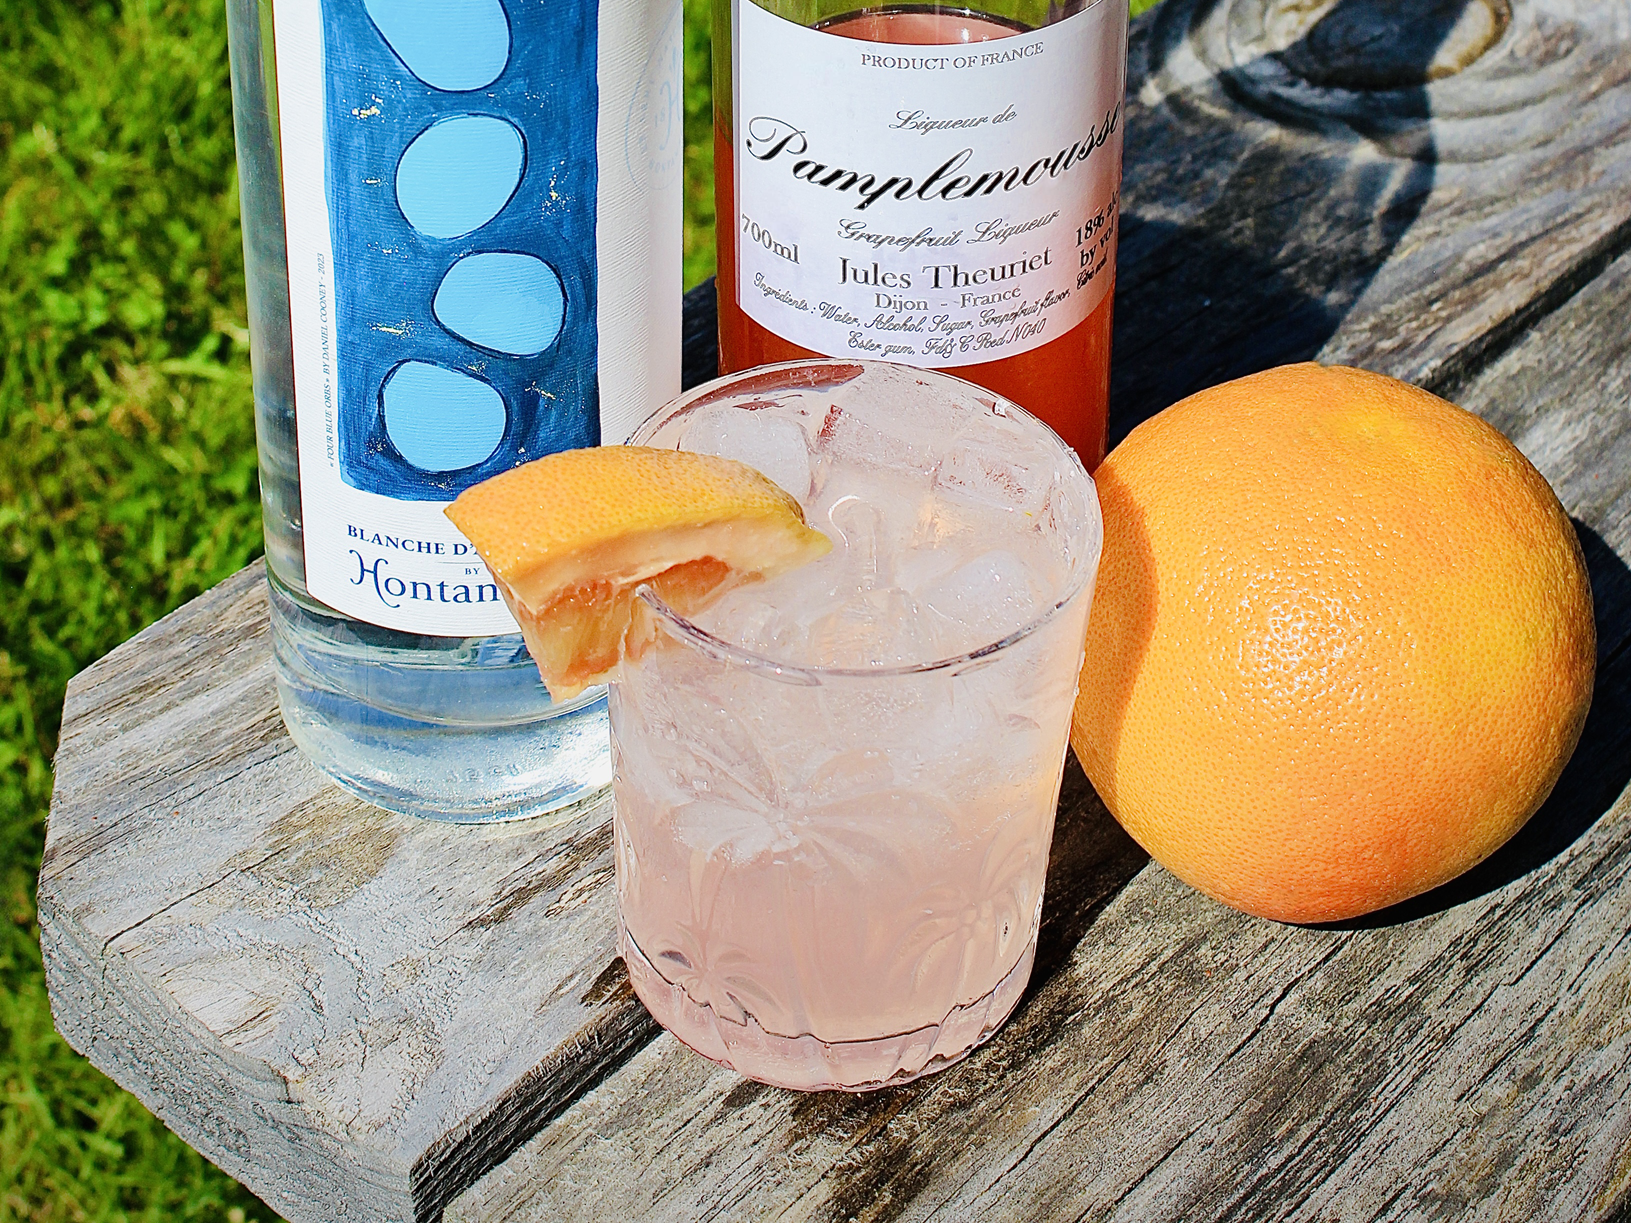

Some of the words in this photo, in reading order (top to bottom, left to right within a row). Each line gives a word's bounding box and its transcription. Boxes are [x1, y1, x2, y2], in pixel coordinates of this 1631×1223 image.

[861, 53, 948, 71] PRODUCT
[952, 55, 979, 68] OF
[980, 41, 1044, 67] FRANCE
[888, 110, 989, 135] Liqueur
[991, 103, 1017, 125] de
[745, 100, 1121, 211] Pamplemousse
[741, 212, 800, 265] 700ml
[837, 218, 960, 253] Grapefruit
[967, 209, 1060, 245] Liqueur
[1076, 209, 1105, 248] 18%
[316, 252, 325, 275] 2023
[837, 257, 911, 289] Jules
[922, 245, 1053, 290] Theuriet
[1080, 244, 1097, 268] by
[318, 281, 328, 323] COONEY
[819, 301, 861, 327] Water,
[864, 314, 927, 333] Alcohol,
[928, 314, 974, 335] Sugar,
[979, 299, 1041, 328] Grapefruit
[1037, 288, 1070, 316] flavor,
[874, 293, 929, 313] Dijon
[960, 288, 1021, 308] France
[320, 325, 330, 361] DANIEL
[847, 331, 882, 349] Ester
[880, 343, 915, 357] gum,
[973, 329, 1010, 351] Red
[322, 361, 330, 375] BY
[323, 383, 331, 409] ORBS
[325, 410, 333, 434] BLUE
[326, 435, 334, 461] FOUR
[347, 524, 446, 555] BLANCHE
